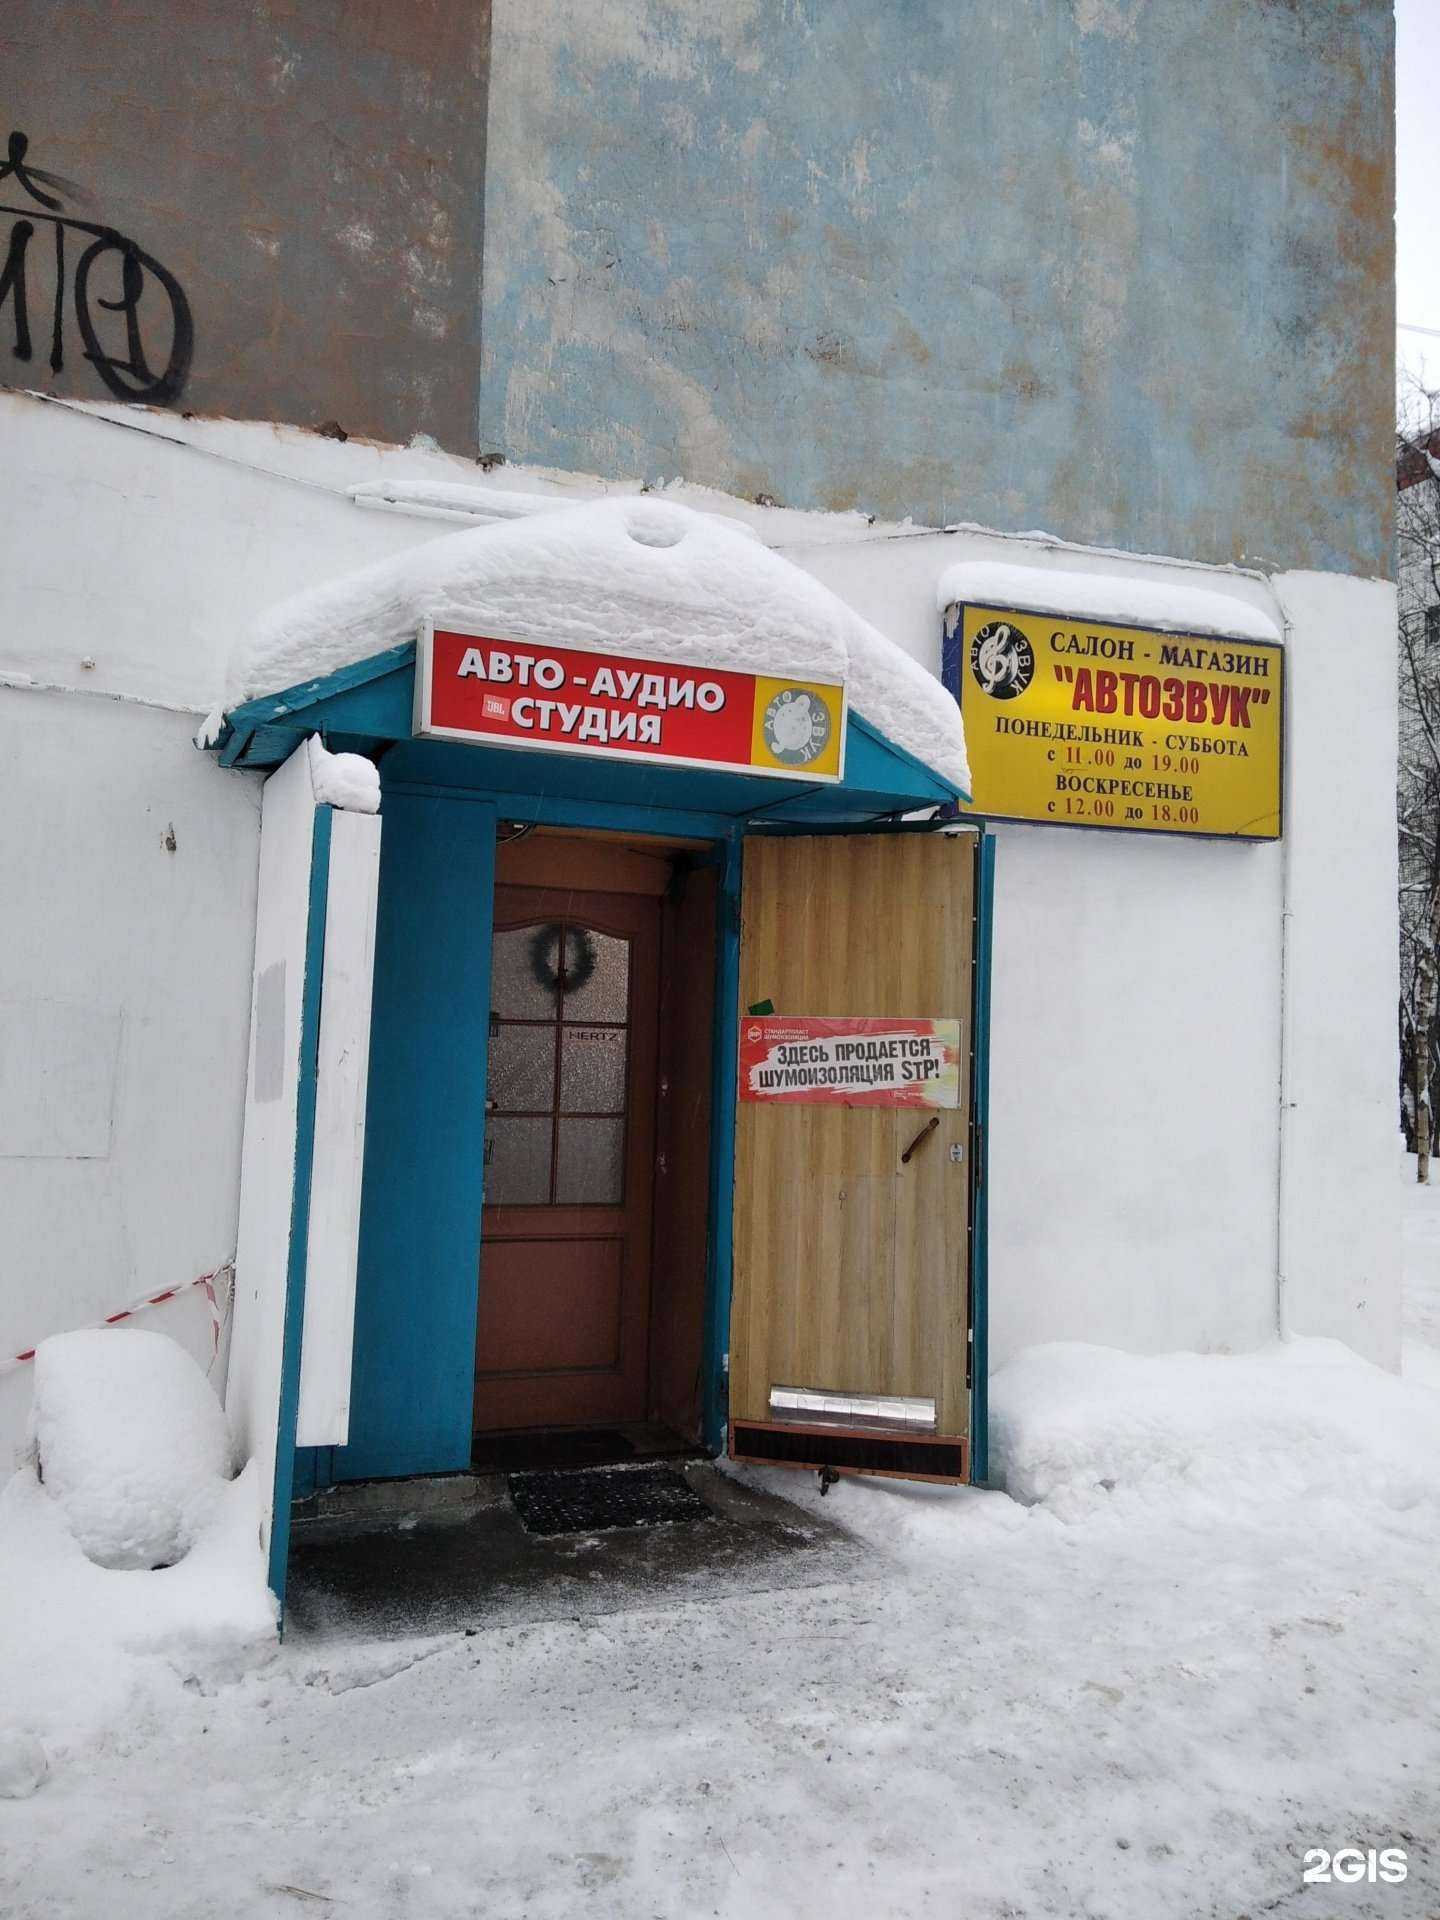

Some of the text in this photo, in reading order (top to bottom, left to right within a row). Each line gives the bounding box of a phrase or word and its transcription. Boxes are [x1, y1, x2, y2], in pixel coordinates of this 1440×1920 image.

[1050, 632, 1135, 661] САЛОН
[1160, 645, 1270, 676] МАГАЗИН
[457, 648, 565, 689] АВТО
[590, 668, 726, 713] АУДИО
[1054, 664, 1271, 728] "АВТОЗВУК"
[510, 698, 663, 745] СТУДИЯ
[995, 716, 1144, 747] ПОНЕДЕЛЬНИК
[1166, 734, 1250, 757] СУББОТА
[1048, 747, 1200, 775] с 11.00 до 19.00
[1056, 774, 1193, 801] ВОСКРЕСЕНЬЕ
[1048, 797, 1199, 824] с 12.00 до 18.00
[569, 1031, 617, 1040] HERTZ
[777, 1038, 931, 1067] ЗДЕСЬ ПРОДАЕТСЯ
[759, 1059, 940, 1088] ШУМОИЗОЛЯЦИЯ STP!
